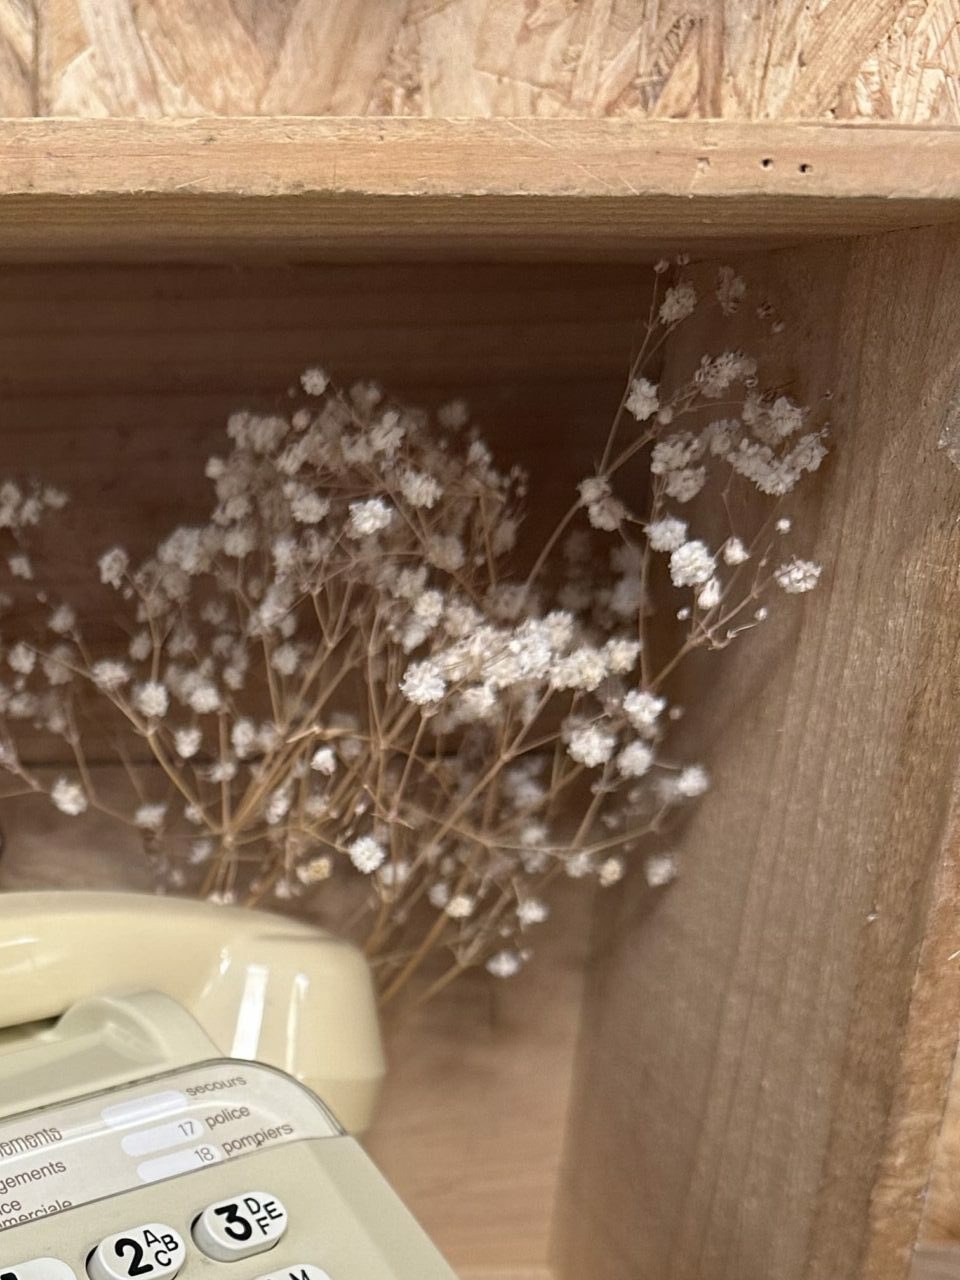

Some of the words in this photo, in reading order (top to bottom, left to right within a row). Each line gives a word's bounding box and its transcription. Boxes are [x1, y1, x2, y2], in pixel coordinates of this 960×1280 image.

[185, 1074, 248, 1097] secours
[177, 1120, 196, 1138] 17
[204, 1104, 251, 1131] police
[193, 1146, 215, 1163] 18
[220, 1122, 295, 1156] pompiers
[214, 1203, 253, 1242] 3
[114, 1238, 154, 1277] 2
